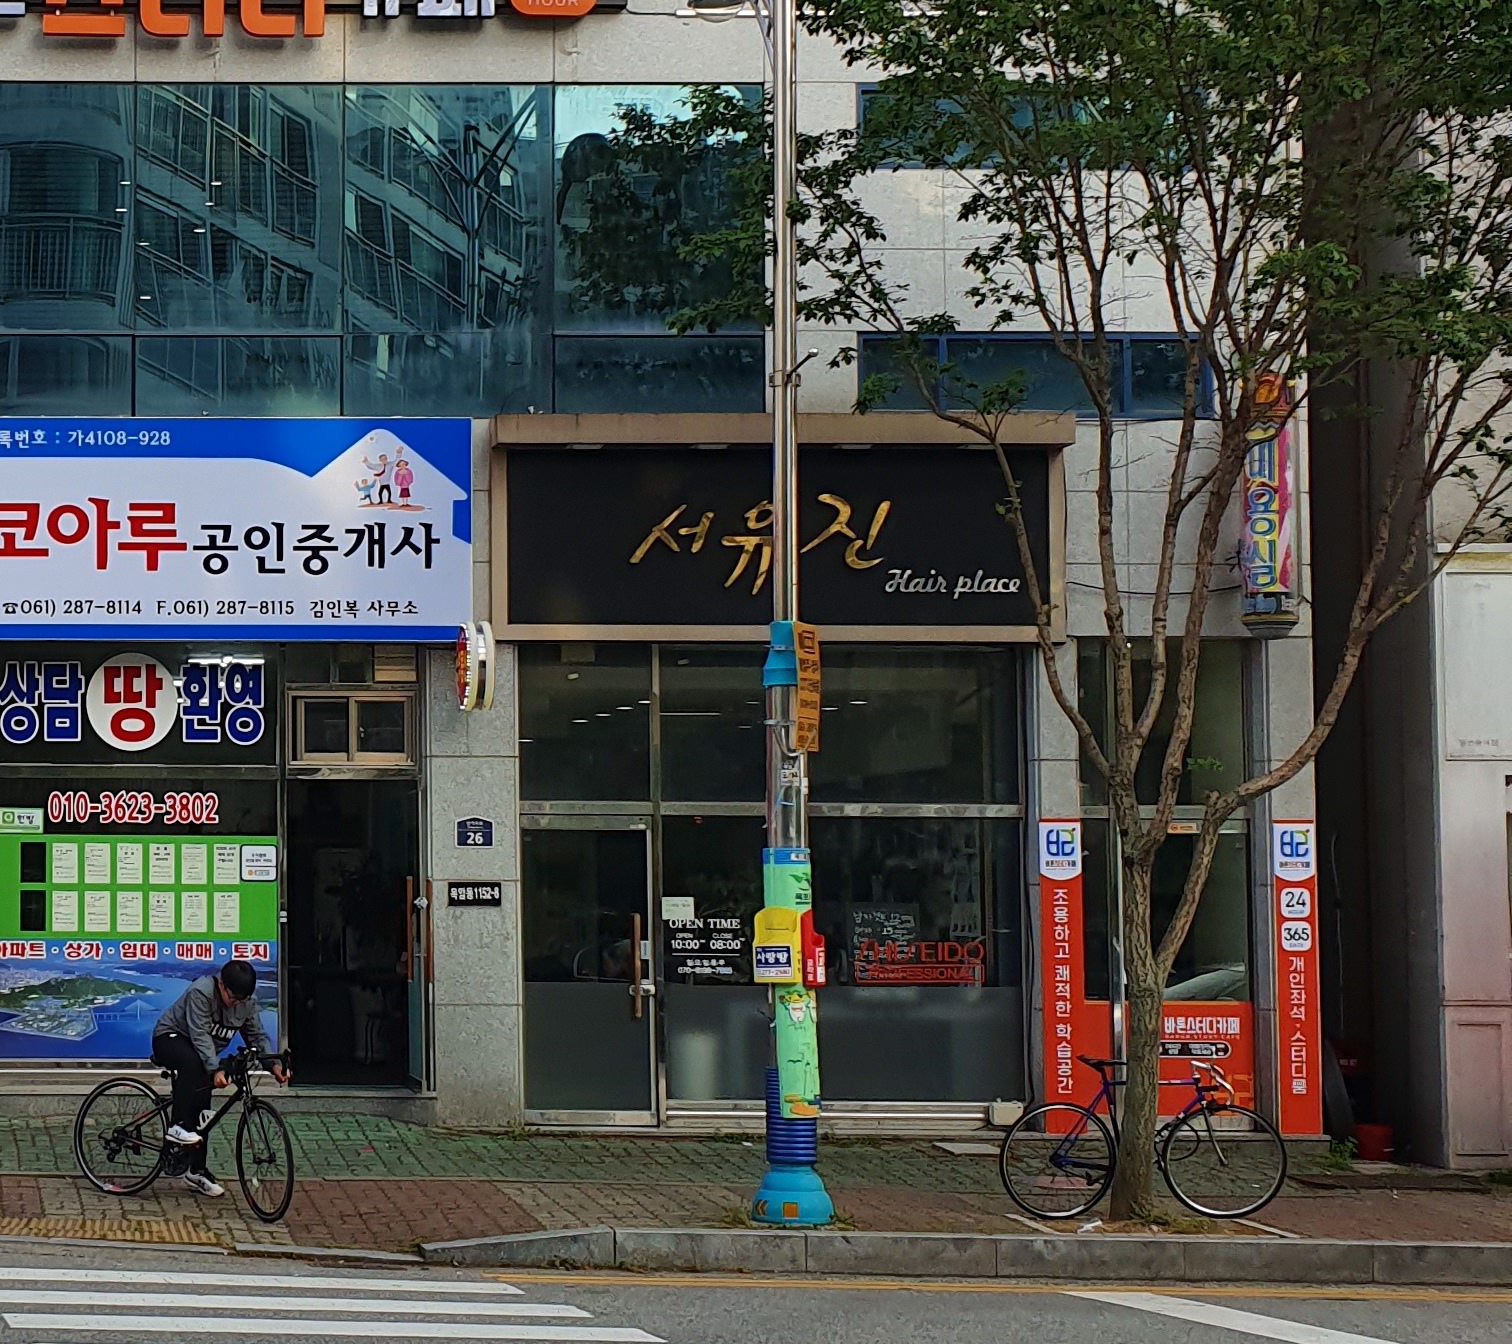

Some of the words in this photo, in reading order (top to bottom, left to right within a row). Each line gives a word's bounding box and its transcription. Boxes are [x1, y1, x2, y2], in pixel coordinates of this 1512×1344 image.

[67, 428, 171, 448] 가4108-928
[629, 493, 891, 596] 서유진
[885, 569, 947, 594] Hair
[952, 574, 1021, 599] place
[20, 599, 56, 616] 061)
[63, 599, 141, 616] 287-8114
[156, 599, 209, 617] F.061)
[216, 599, 294, 616] 287-8115
[309, 600, 360, 618] 김인복
[367, 600, 419, 618] 사무소
[103, 663, 163, 743] 땅
[180, 662, 265, 745] 환영
[48, 791, 219, 824] 010-3623-3802
[467, 832, 484, 844] 26
[1285, 892, 1306, 907] 24
[669, 919, 704, 928] OPEN
[707, 919, 741, 928] TIME
[1052, 889, 1070, 959] 조용하고
[1284, 928, 1309, 941] 365
[64, 942, 102, 960] 상가
[120, 942, 157, 960] 임대
[175, 942, 212, 960] 매매
[232, 943, 269, 960] 토지
[756, 952, 789, 963] 사랑방
[1055, 965, 1071, 1018] 쾌적한
[1288, 957, 1306, 1021] 개인좌석
[1163, 1017, 1240, 1034] 바른스터디카페
[1055, 1023, 1073, 1093] 학습공간
[1290, 1032, 1307, 1094] 스터디룸
